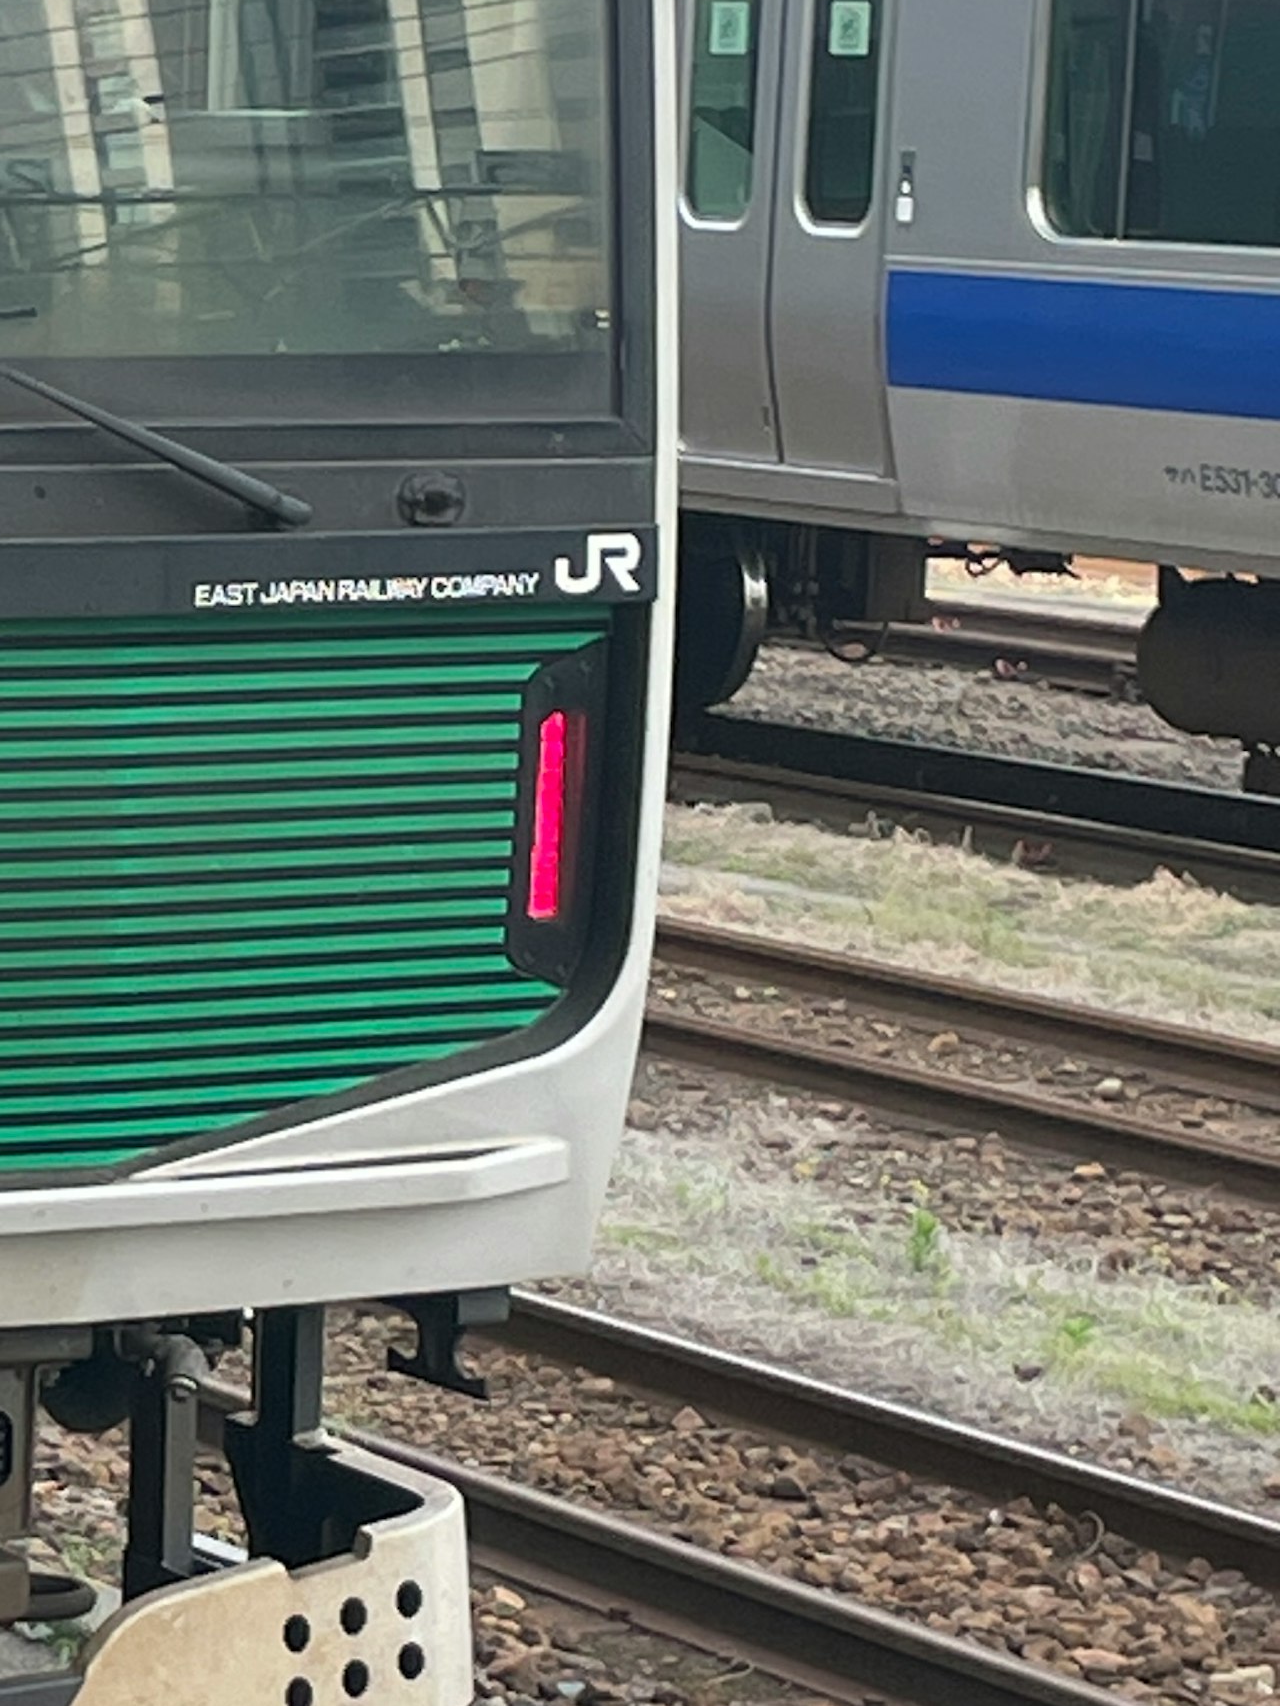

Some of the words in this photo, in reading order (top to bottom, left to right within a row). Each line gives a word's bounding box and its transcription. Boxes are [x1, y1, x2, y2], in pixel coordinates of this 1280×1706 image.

[554, 532, 641, 593] JR
[194, 582, 259, 608] EAST
[260, 579, 337, 605] JAPAN
[338, 577, 429, 602] RAILWAY
[431, 572, 540, 599] COMPANY
